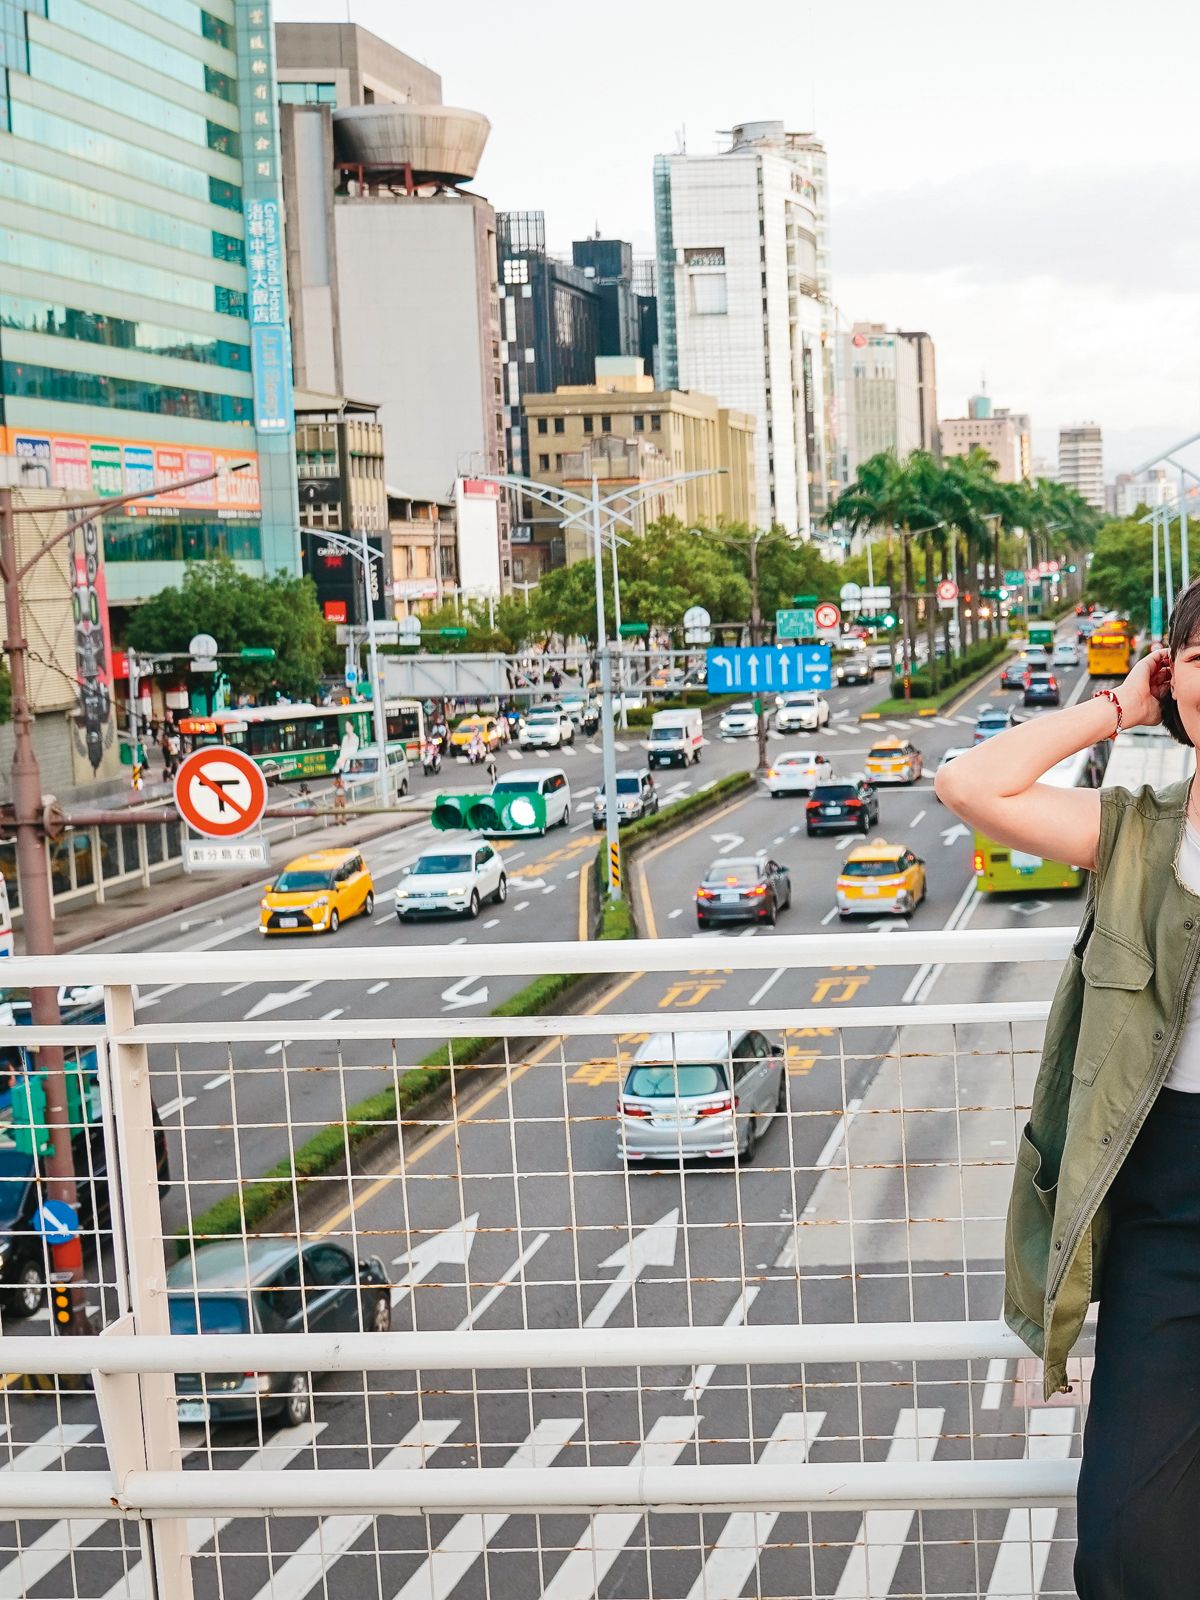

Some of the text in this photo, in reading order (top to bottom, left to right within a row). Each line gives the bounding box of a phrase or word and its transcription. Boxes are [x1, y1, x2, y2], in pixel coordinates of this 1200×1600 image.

[264, 202, 282, 323] Green World Hotel
[370, 563, 379, 601] SONY
[193, 848, 260, 861] 劃分島左側
